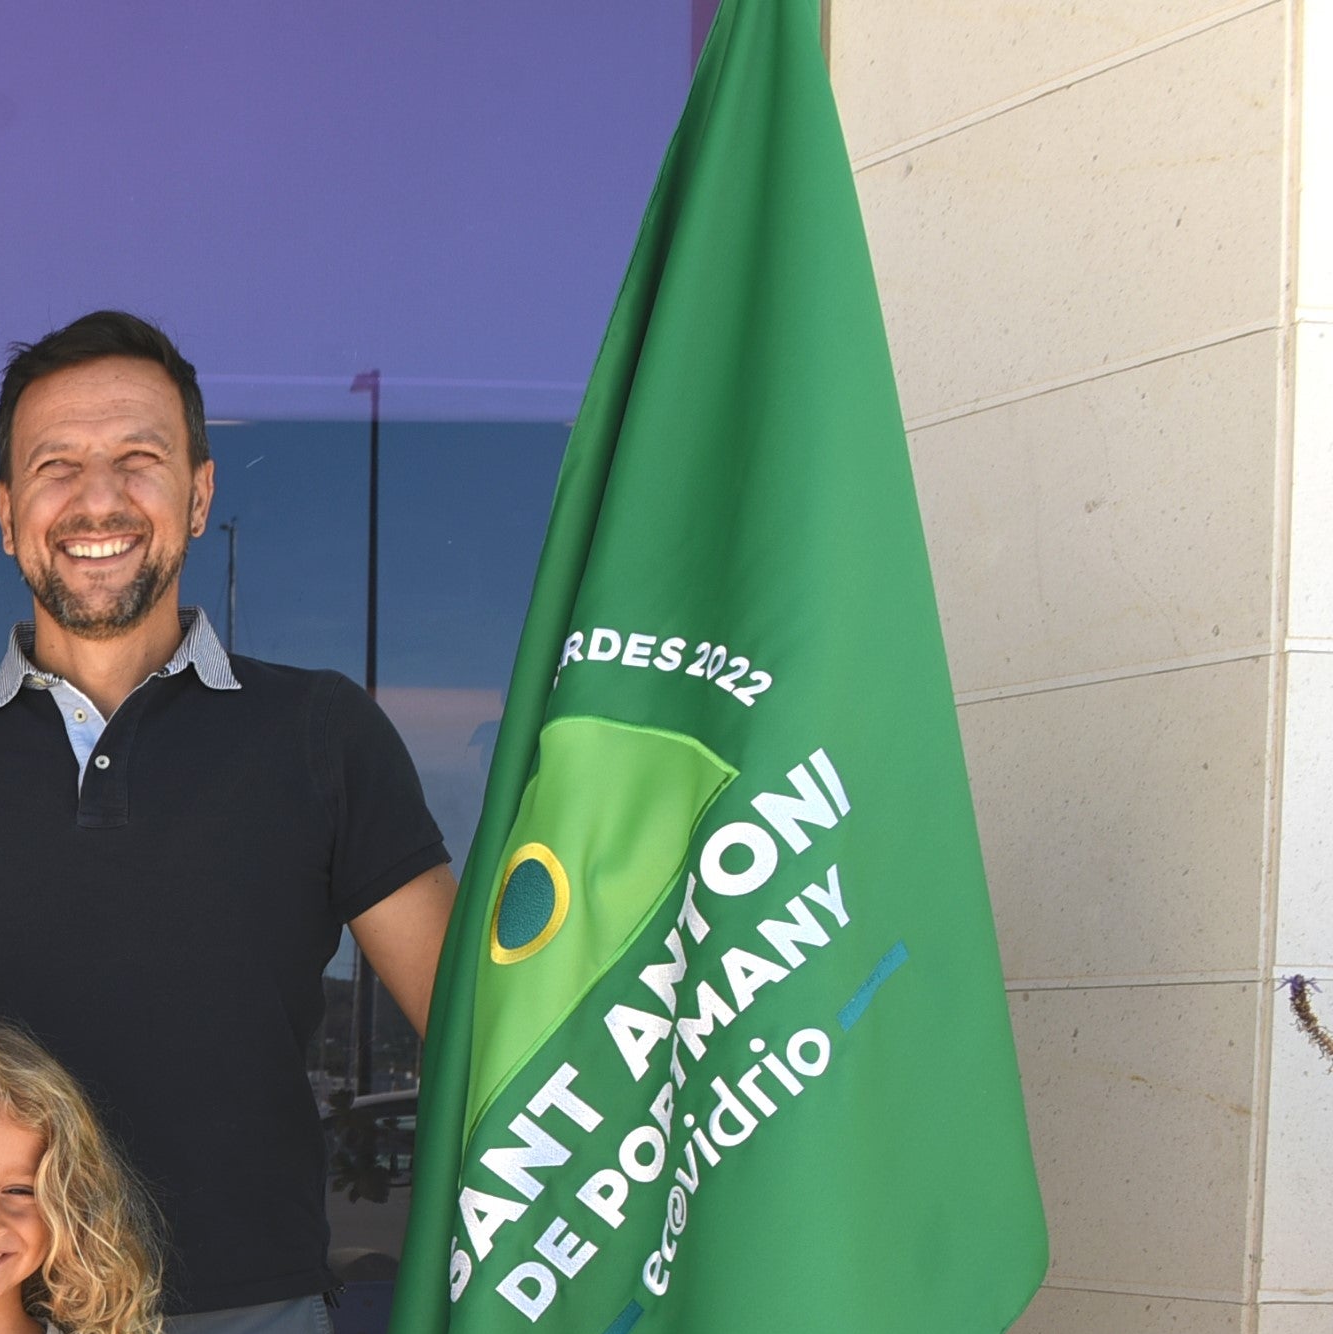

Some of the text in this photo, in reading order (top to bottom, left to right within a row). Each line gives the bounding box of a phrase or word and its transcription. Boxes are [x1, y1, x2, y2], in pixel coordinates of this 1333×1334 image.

[554, 628, 773, 707] RDES 2022
[450, 748, 851, 1303] SANT ANTONI
[495, 864, 851, 1323] DE PORTMANY
